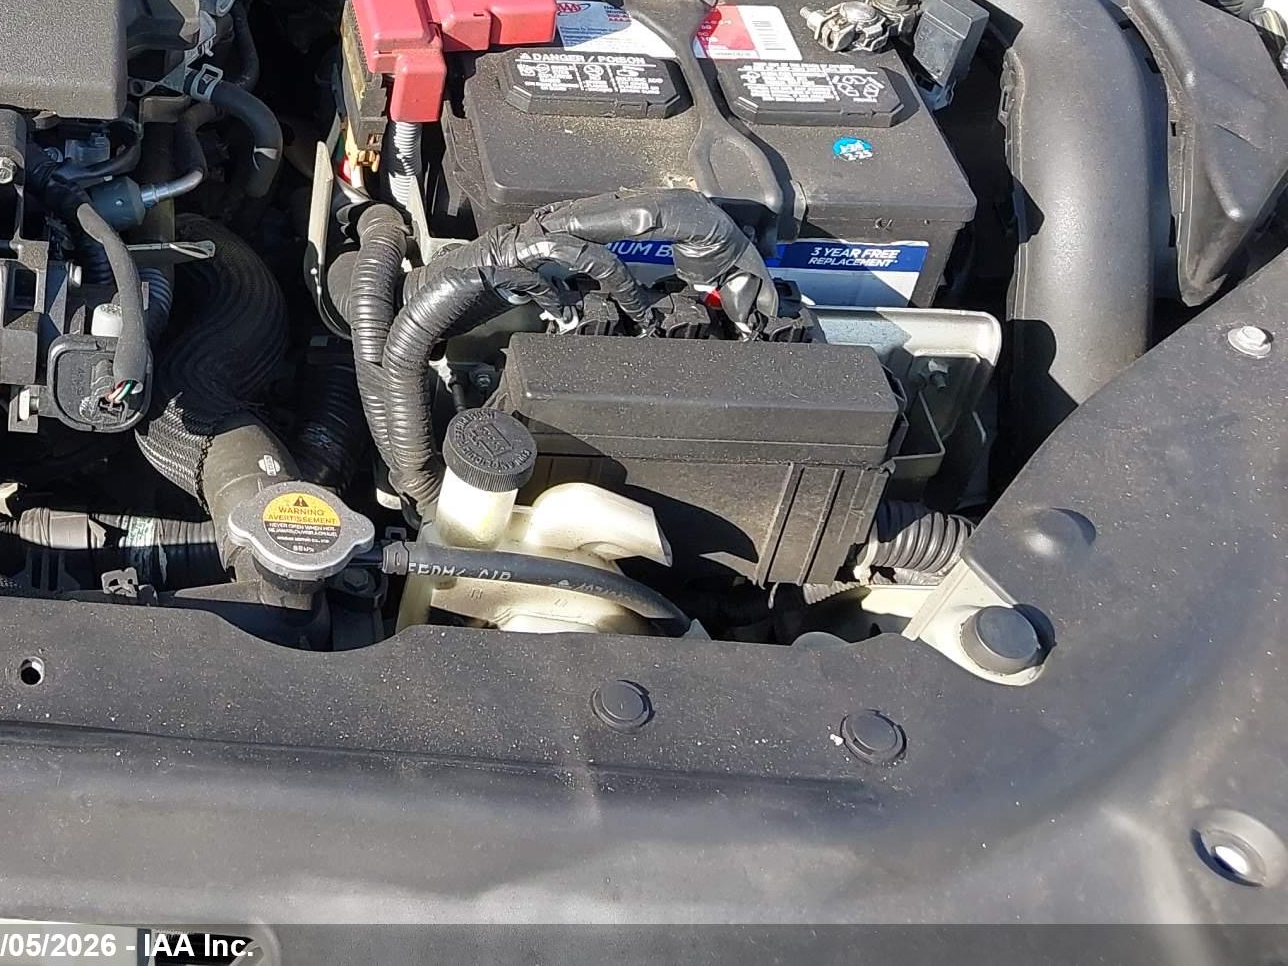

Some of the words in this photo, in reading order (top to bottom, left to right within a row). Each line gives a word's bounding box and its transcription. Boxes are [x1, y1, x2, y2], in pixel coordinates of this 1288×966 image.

[531, 52, 585, 62] DANGER
[597, 55, 646, 65] POISON
[811, 247, 822, 256] 3
[824, 247, 859, 258] YEAR
[861, 248, 900, 259] FREE
[278, 506, 325, 516] WARNING
[268, 514, 337, 524] AVERTISSEMENT
